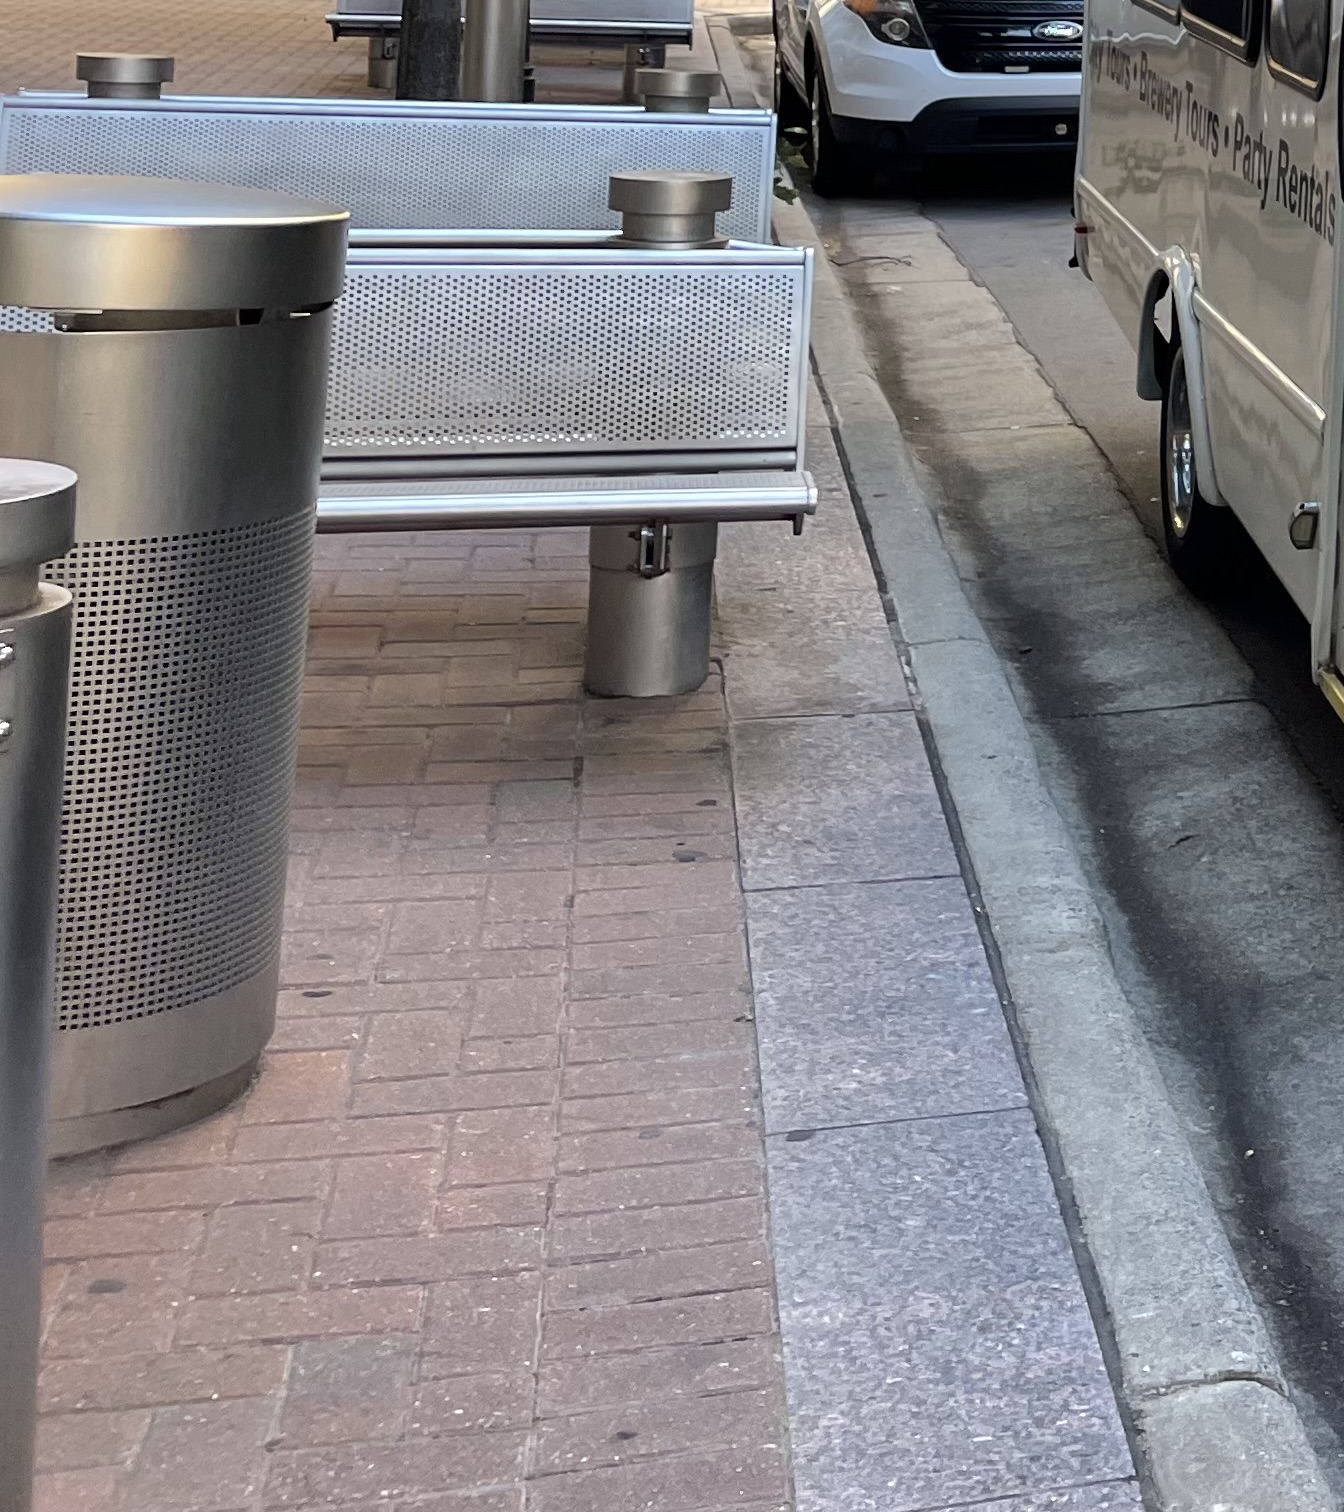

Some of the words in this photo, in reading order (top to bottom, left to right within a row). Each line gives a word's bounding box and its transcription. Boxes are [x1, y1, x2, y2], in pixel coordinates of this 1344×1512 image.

[1139, 50, 1182, 143] Brewery
[1185, 80, 1220, 158] Tours
[1233, 112, 1273, 211] Party
[1275, 138, 1336, 248] Rentals
